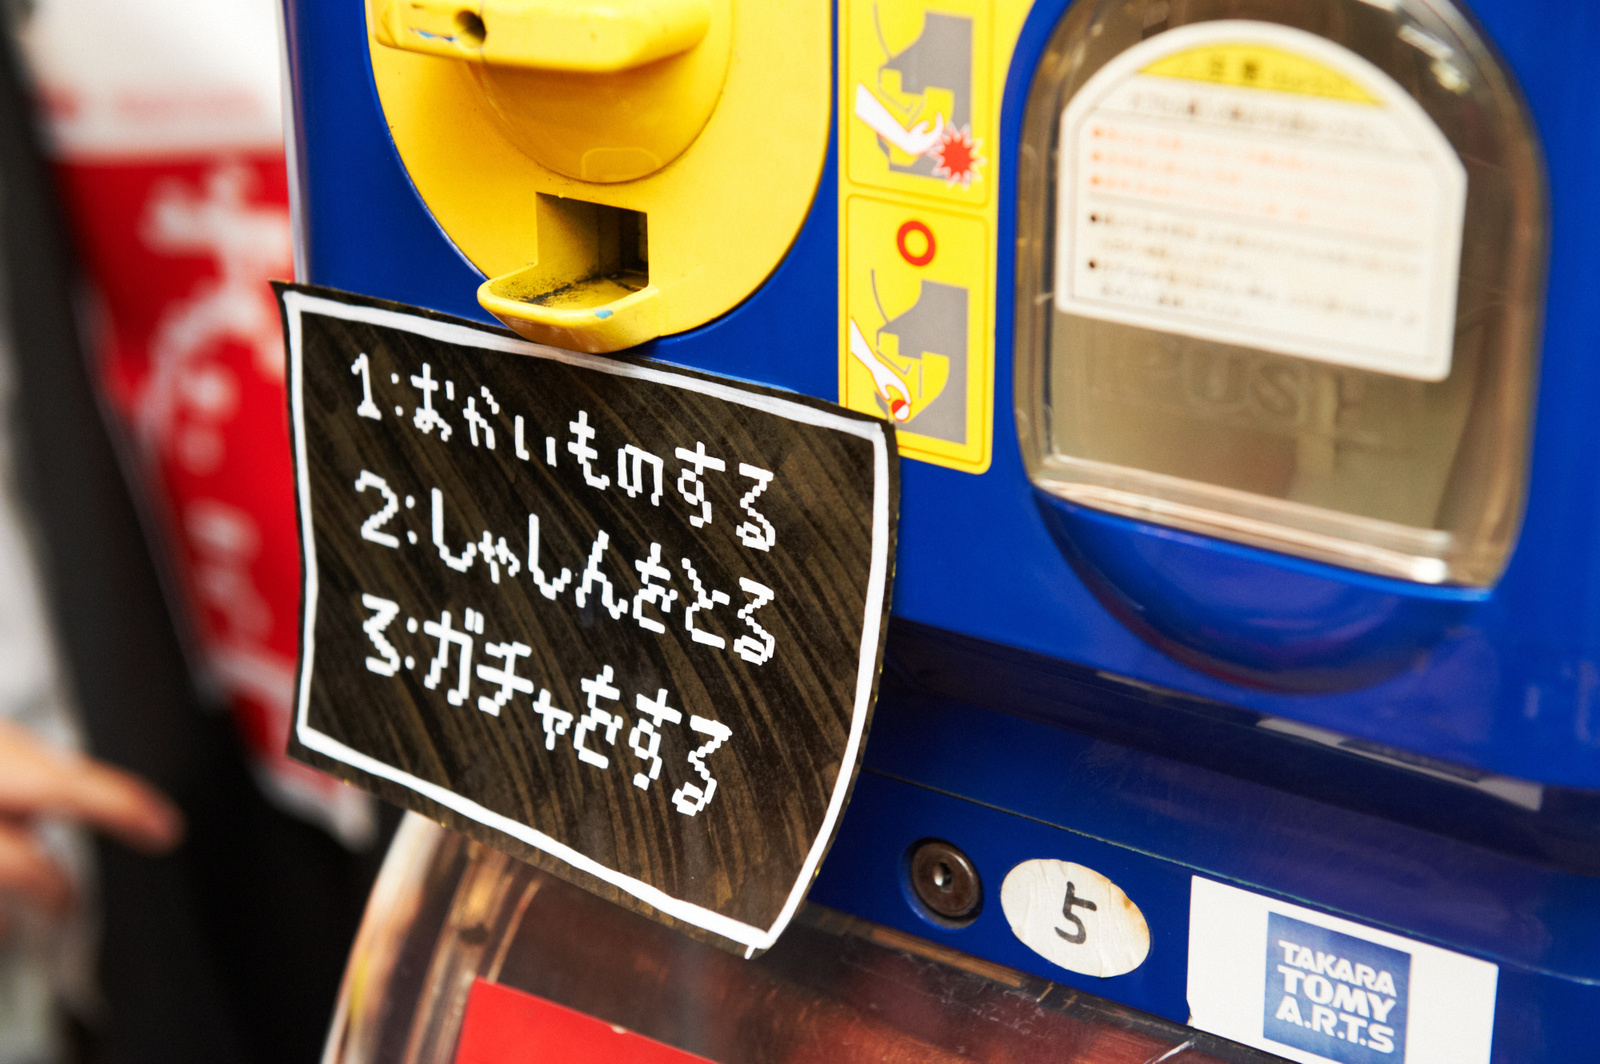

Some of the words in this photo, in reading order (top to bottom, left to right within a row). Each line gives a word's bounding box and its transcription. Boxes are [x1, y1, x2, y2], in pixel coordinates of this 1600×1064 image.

[1053, 880, 1098, 945] 5
[1276, 963, 1397, 1028] TOMY
[1277, 939, 1398, 998] TAKARA
[1275, 994, 1395, 1054] A.R.T.S
